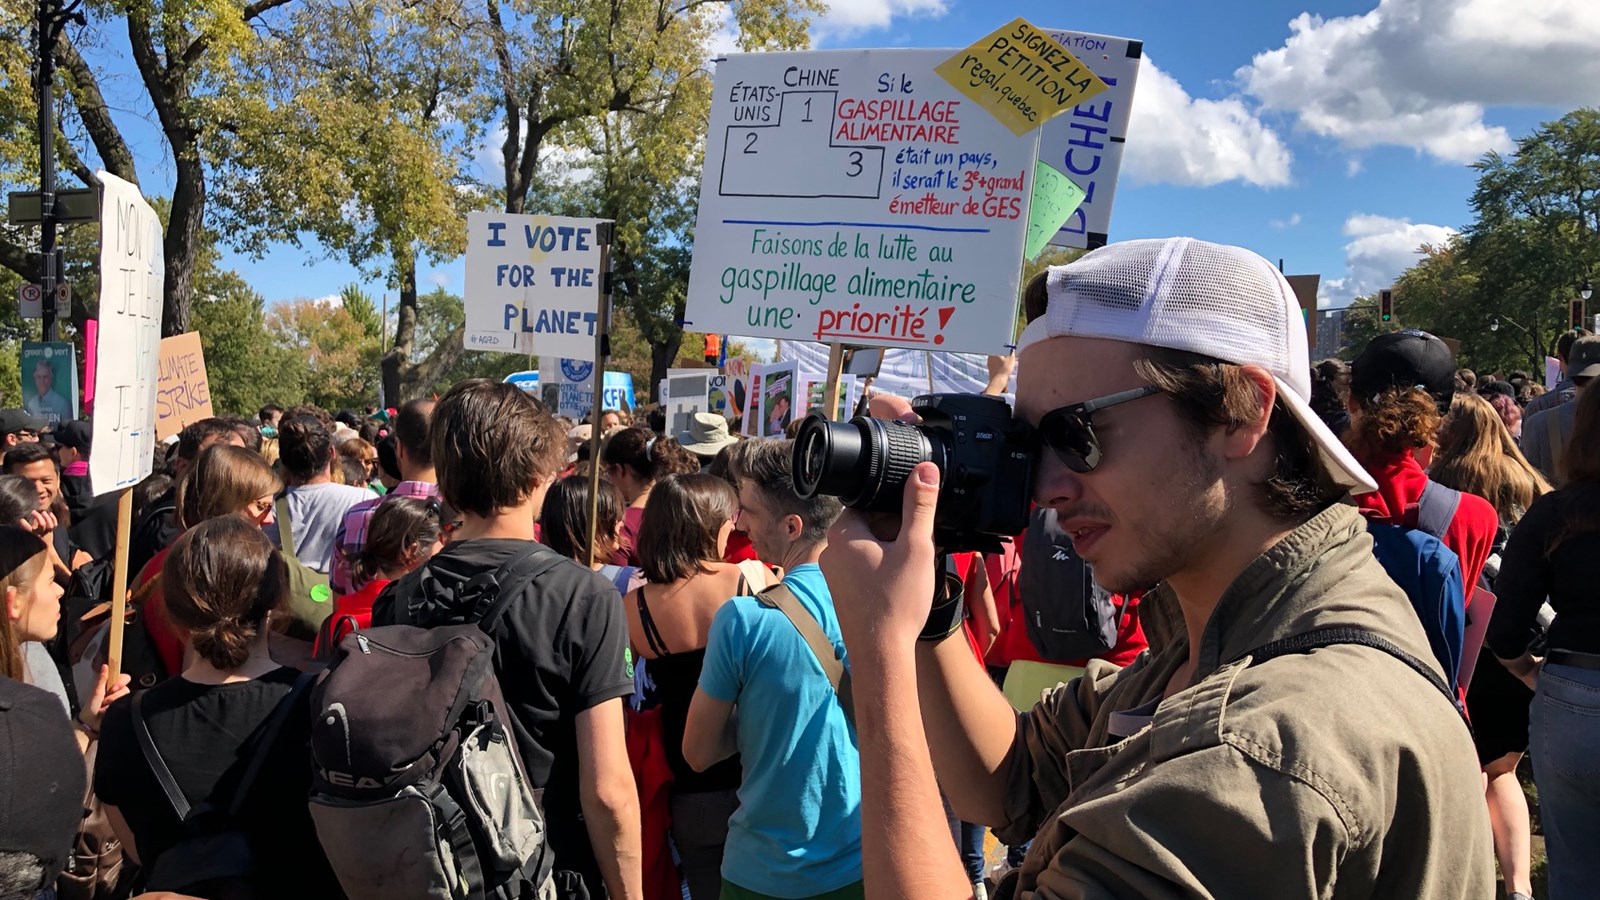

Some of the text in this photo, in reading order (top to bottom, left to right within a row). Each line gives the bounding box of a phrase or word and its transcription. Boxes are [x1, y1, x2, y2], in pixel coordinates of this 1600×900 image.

[987, 36, 1072, 106] PETITION
[1011, 24, 1092, 94] SIGNEZ LA
[783, 66, 840, 87] CHINE
[878, 72, 914, 94] Si le
[729, 81, 781, 103] ÉTATS-
[733, 105, 771, 122] UNIS
[801, 97, 813, 122] 1
[838, 98, 961, 124] GASPILLAGE
[743, 132, 758, 154] 2
[835, 121, 960, 144] ALIMENTAIRE
[846, 151, 864, 177] 3
[895, 146, 997, 171] était un pays,
[892, 168, 902, 188] il
[902, 169, 945, 190] serait
[946, 170, 959, 189] le
[889, 192, 1022, 220] émetteur de GES
[487, 222, 592, 253] I VOTE
[751, 229, 953, 263] Faisons de la lutte au
[497, 264, 594, 288] FOR THE
[719, 262, 976, 305] gaspillage alimentaire
[504, 303, 598, 337] PLANET
[747, 305, 794, 330] une
[24, 347, 69, 359] green vert
[560, 383, 579, 392] OTRE
[559, 401, 579, 410] OTRE
[320, 768, 398, 789] EA
